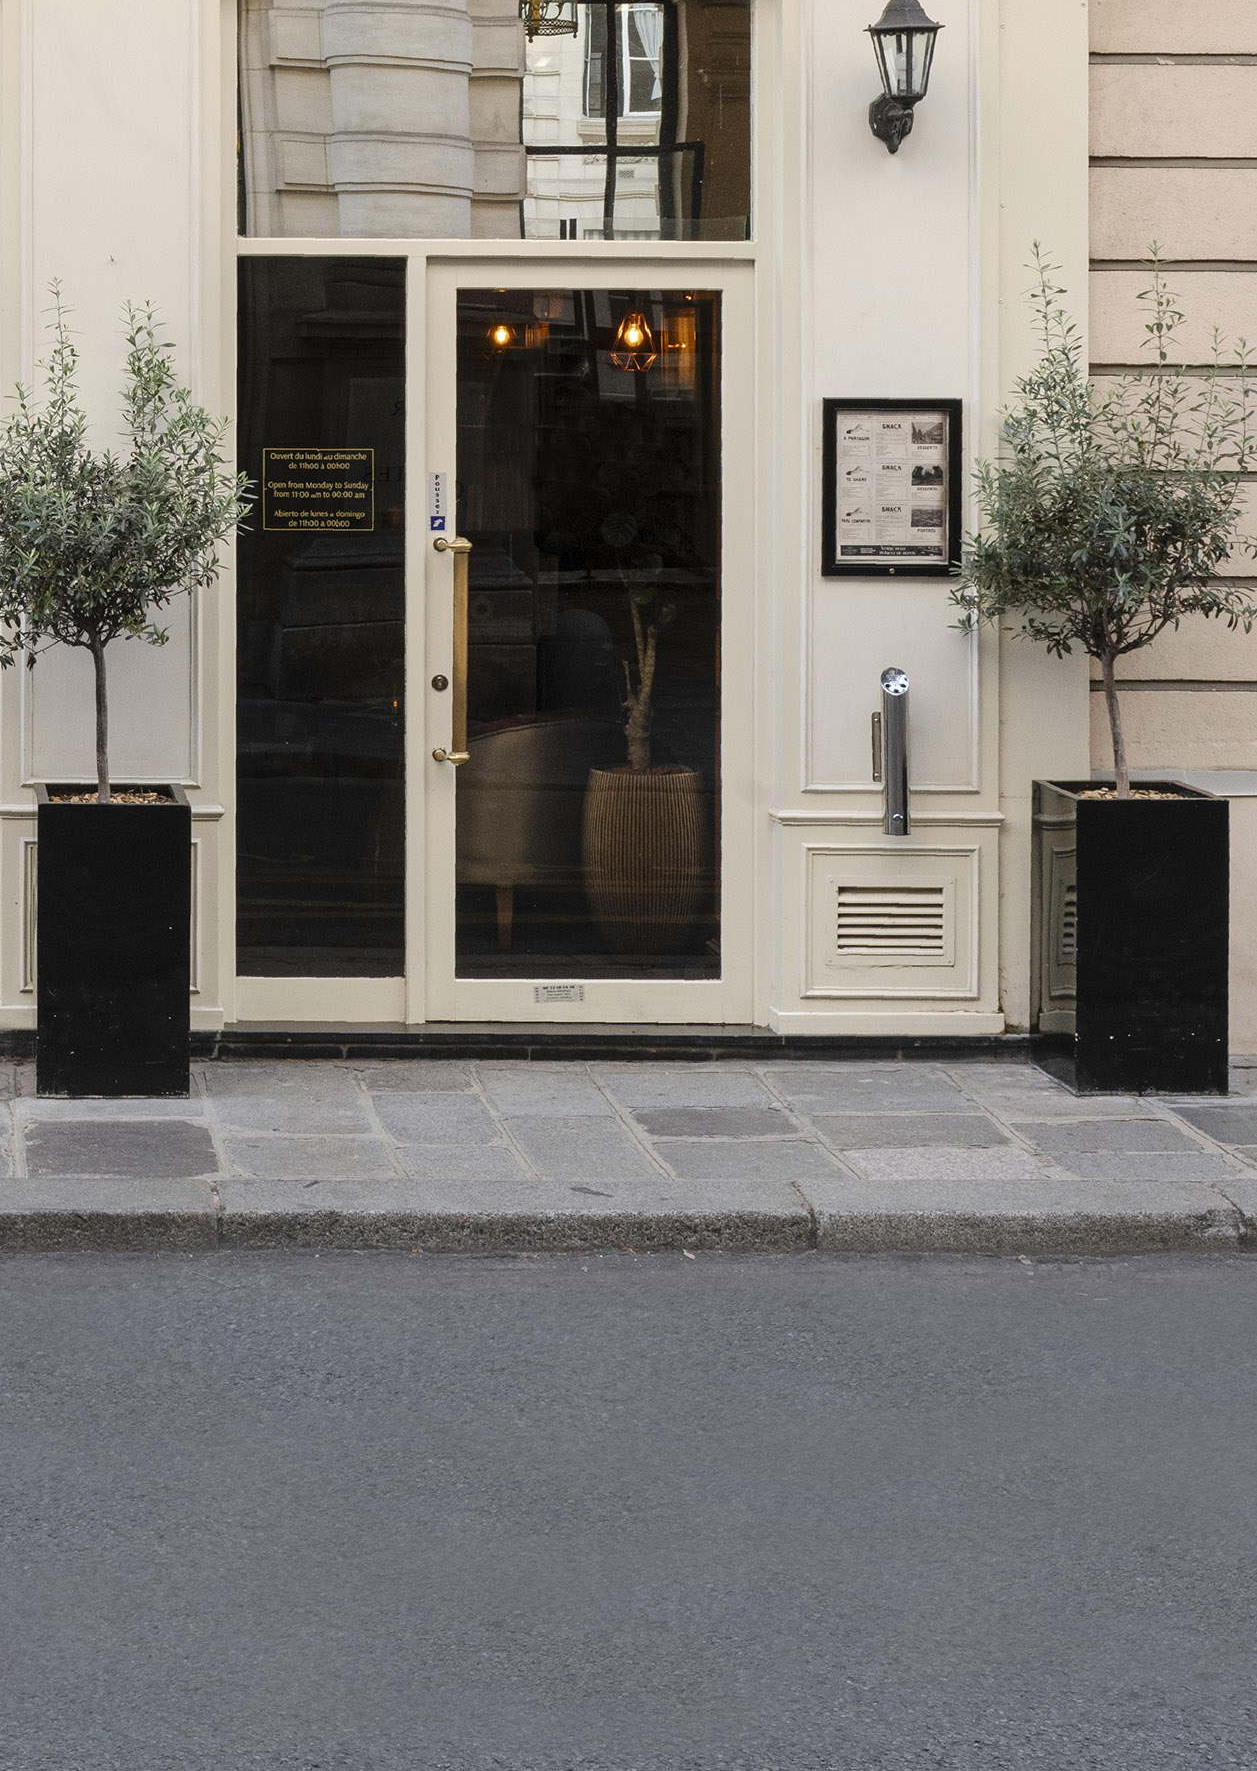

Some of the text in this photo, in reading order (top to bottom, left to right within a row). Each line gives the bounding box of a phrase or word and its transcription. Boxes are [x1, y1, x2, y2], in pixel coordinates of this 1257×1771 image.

[270, 452, 293, 460] Ouvert
[295, 452, 304, 460] du
[305, 452, 323, 460] lundi
[334, 452, 367, 460] dimanche
[268, 481, 286, 490] Open
[288, 481, 304, 489] from
[306, 481, 333, 490] Monday
[344, 481, 369, 490] Sunday
[336, 510, 365, 519] domingo
